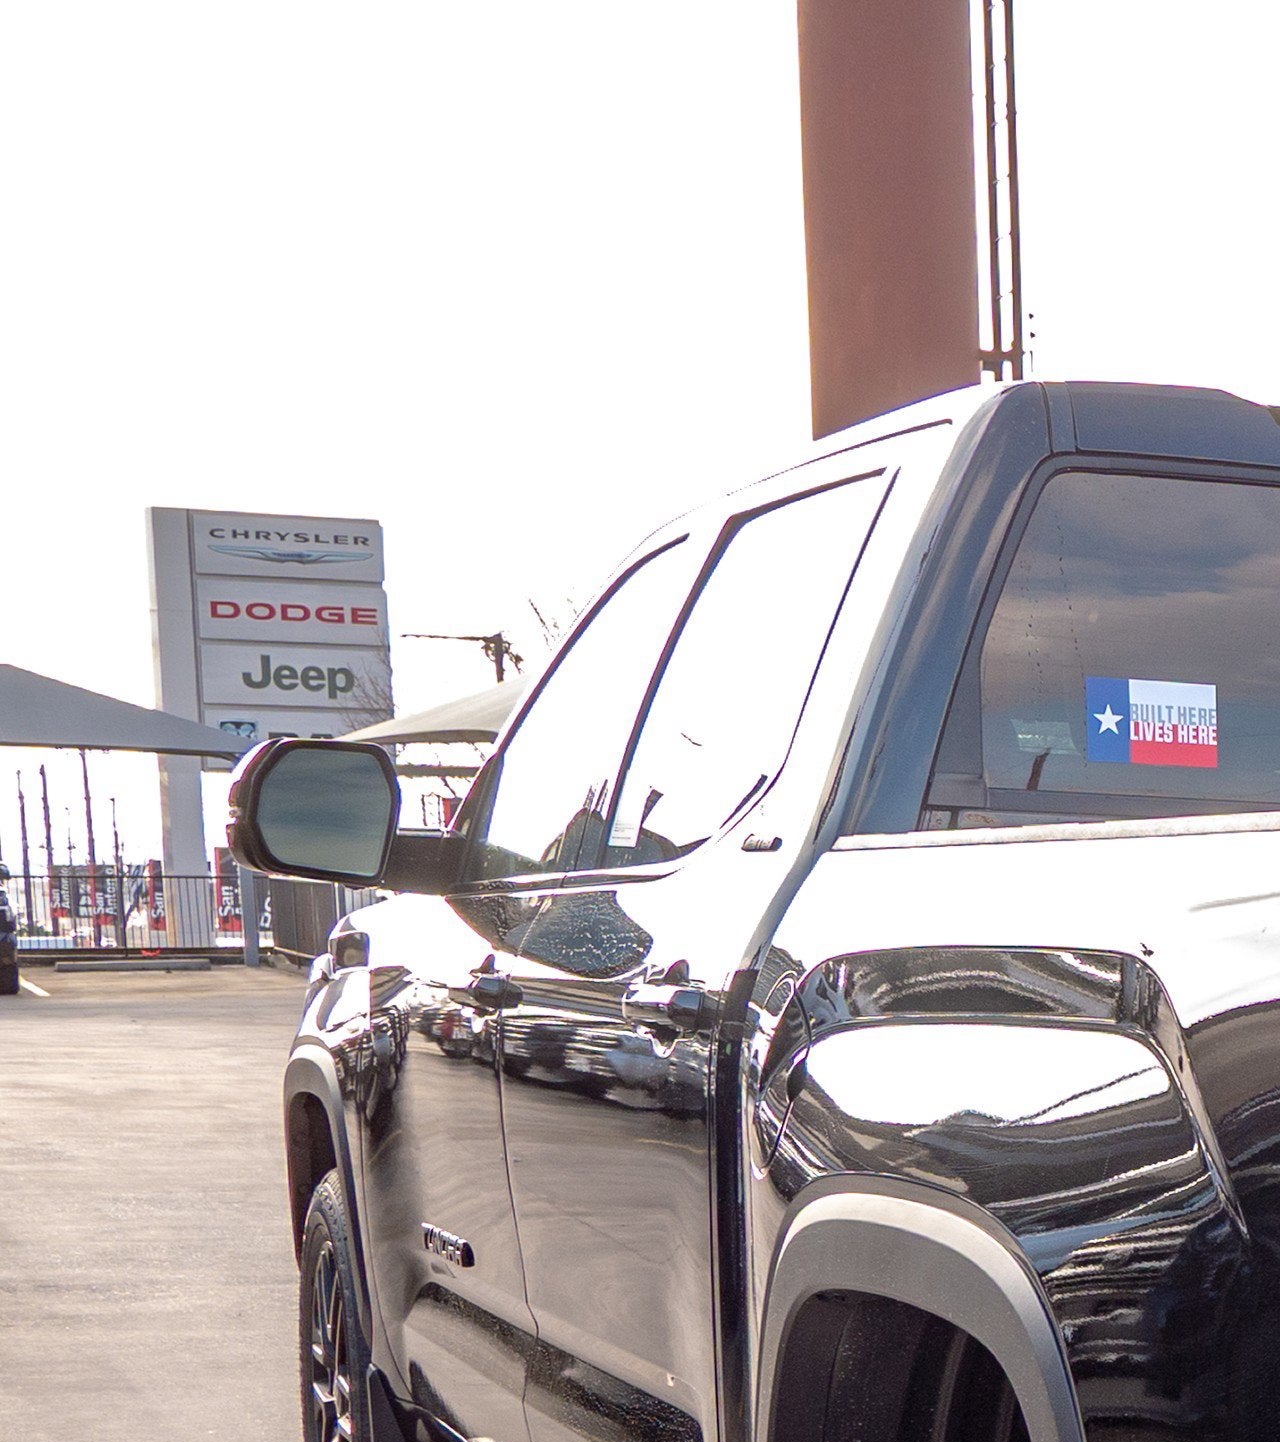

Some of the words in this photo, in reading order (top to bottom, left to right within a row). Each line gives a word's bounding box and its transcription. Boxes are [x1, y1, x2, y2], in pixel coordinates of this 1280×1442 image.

[209, 528, 370, 546] CHRYSLER
[210, 601, 378, 625] DODGE
[242, 654, 354, 699] Jeep
[1130, 703, 1173, 724] BUILT
[1177, 707, 1217, 726] HERE
[1130, 721, 1173, 743] LIVES
[1177, 725, 1217, 746] HERE
[93, 892, 104, 915] San
[105, 867, 117, 916] Antono
[219, 886, 234, 916] San
[151, 892, 164, 918] San
